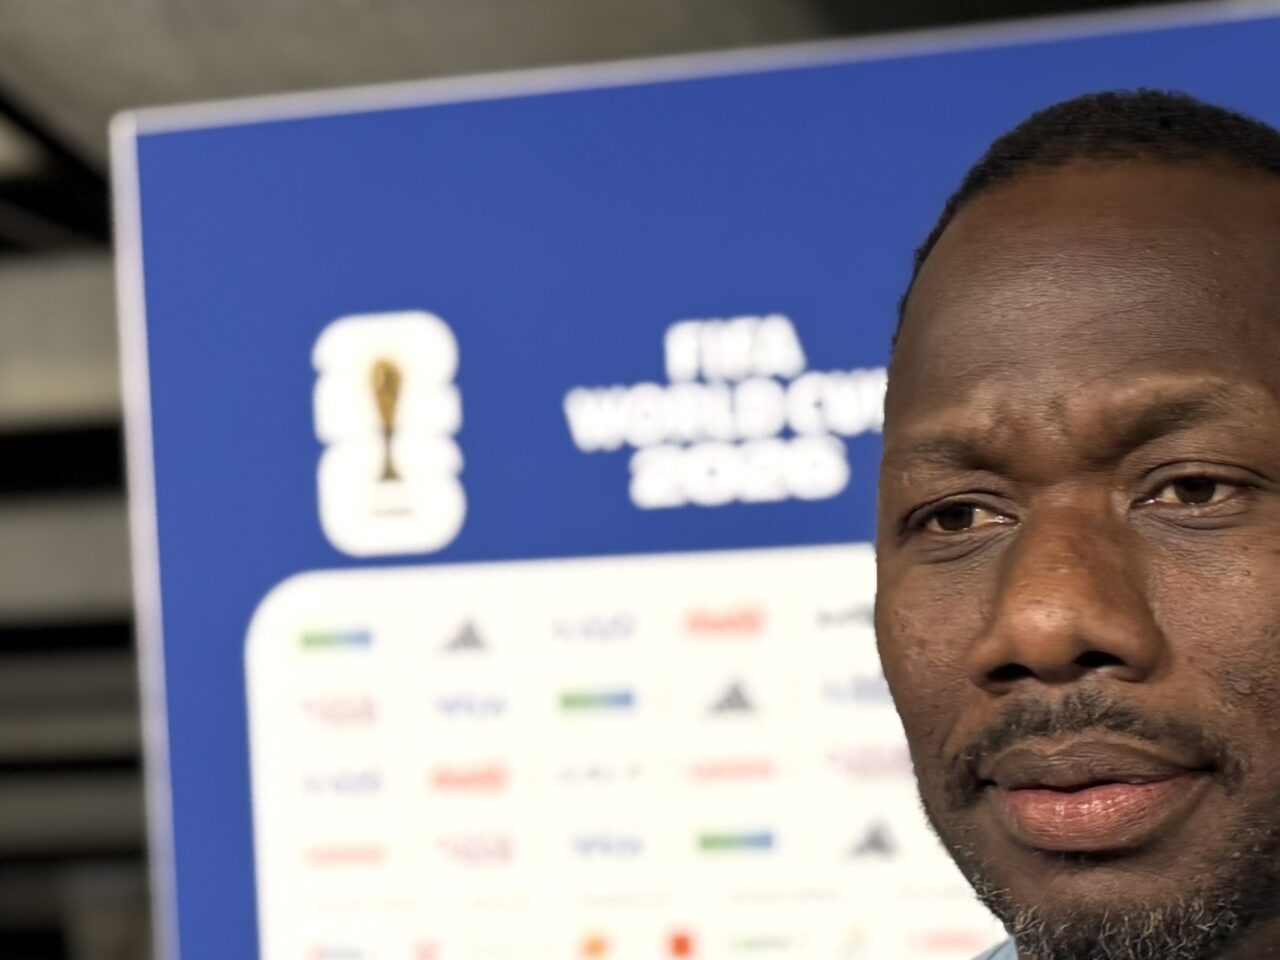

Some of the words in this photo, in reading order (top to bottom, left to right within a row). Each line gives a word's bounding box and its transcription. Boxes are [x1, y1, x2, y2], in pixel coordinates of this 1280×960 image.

[664, 313, 807, 384] FIFA
[563, 375, 787, 453] WORLD
[629, 432, 851, 510] 2026
